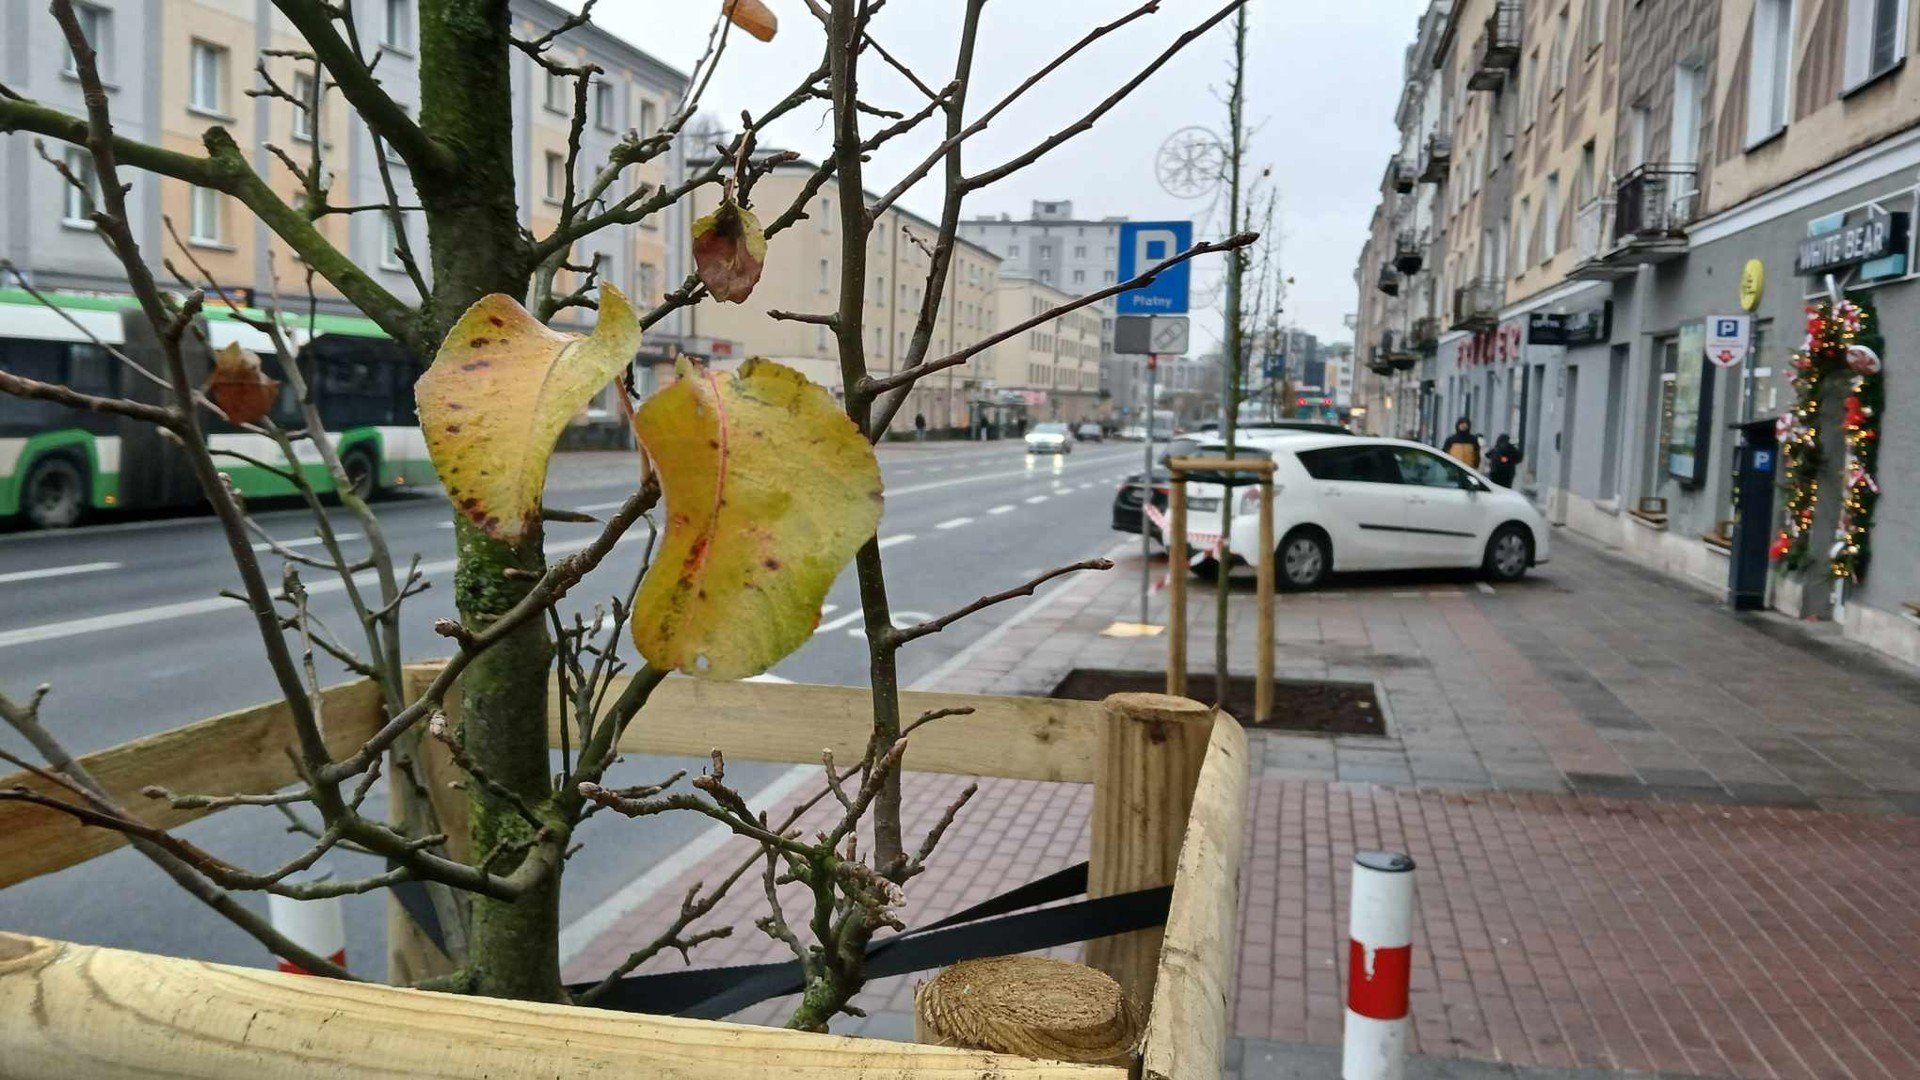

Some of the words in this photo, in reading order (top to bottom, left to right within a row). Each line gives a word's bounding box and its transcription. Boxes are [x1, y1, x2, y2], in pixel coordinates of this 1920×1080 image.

[1135, 229, 1177, 280] P
[1799, 234, 1842, 270] WHITE
[1844, 221, 1884, 260] BEAR
[1721, 321, 1735, 336] P
[1754, 451, 1769, 469] P
